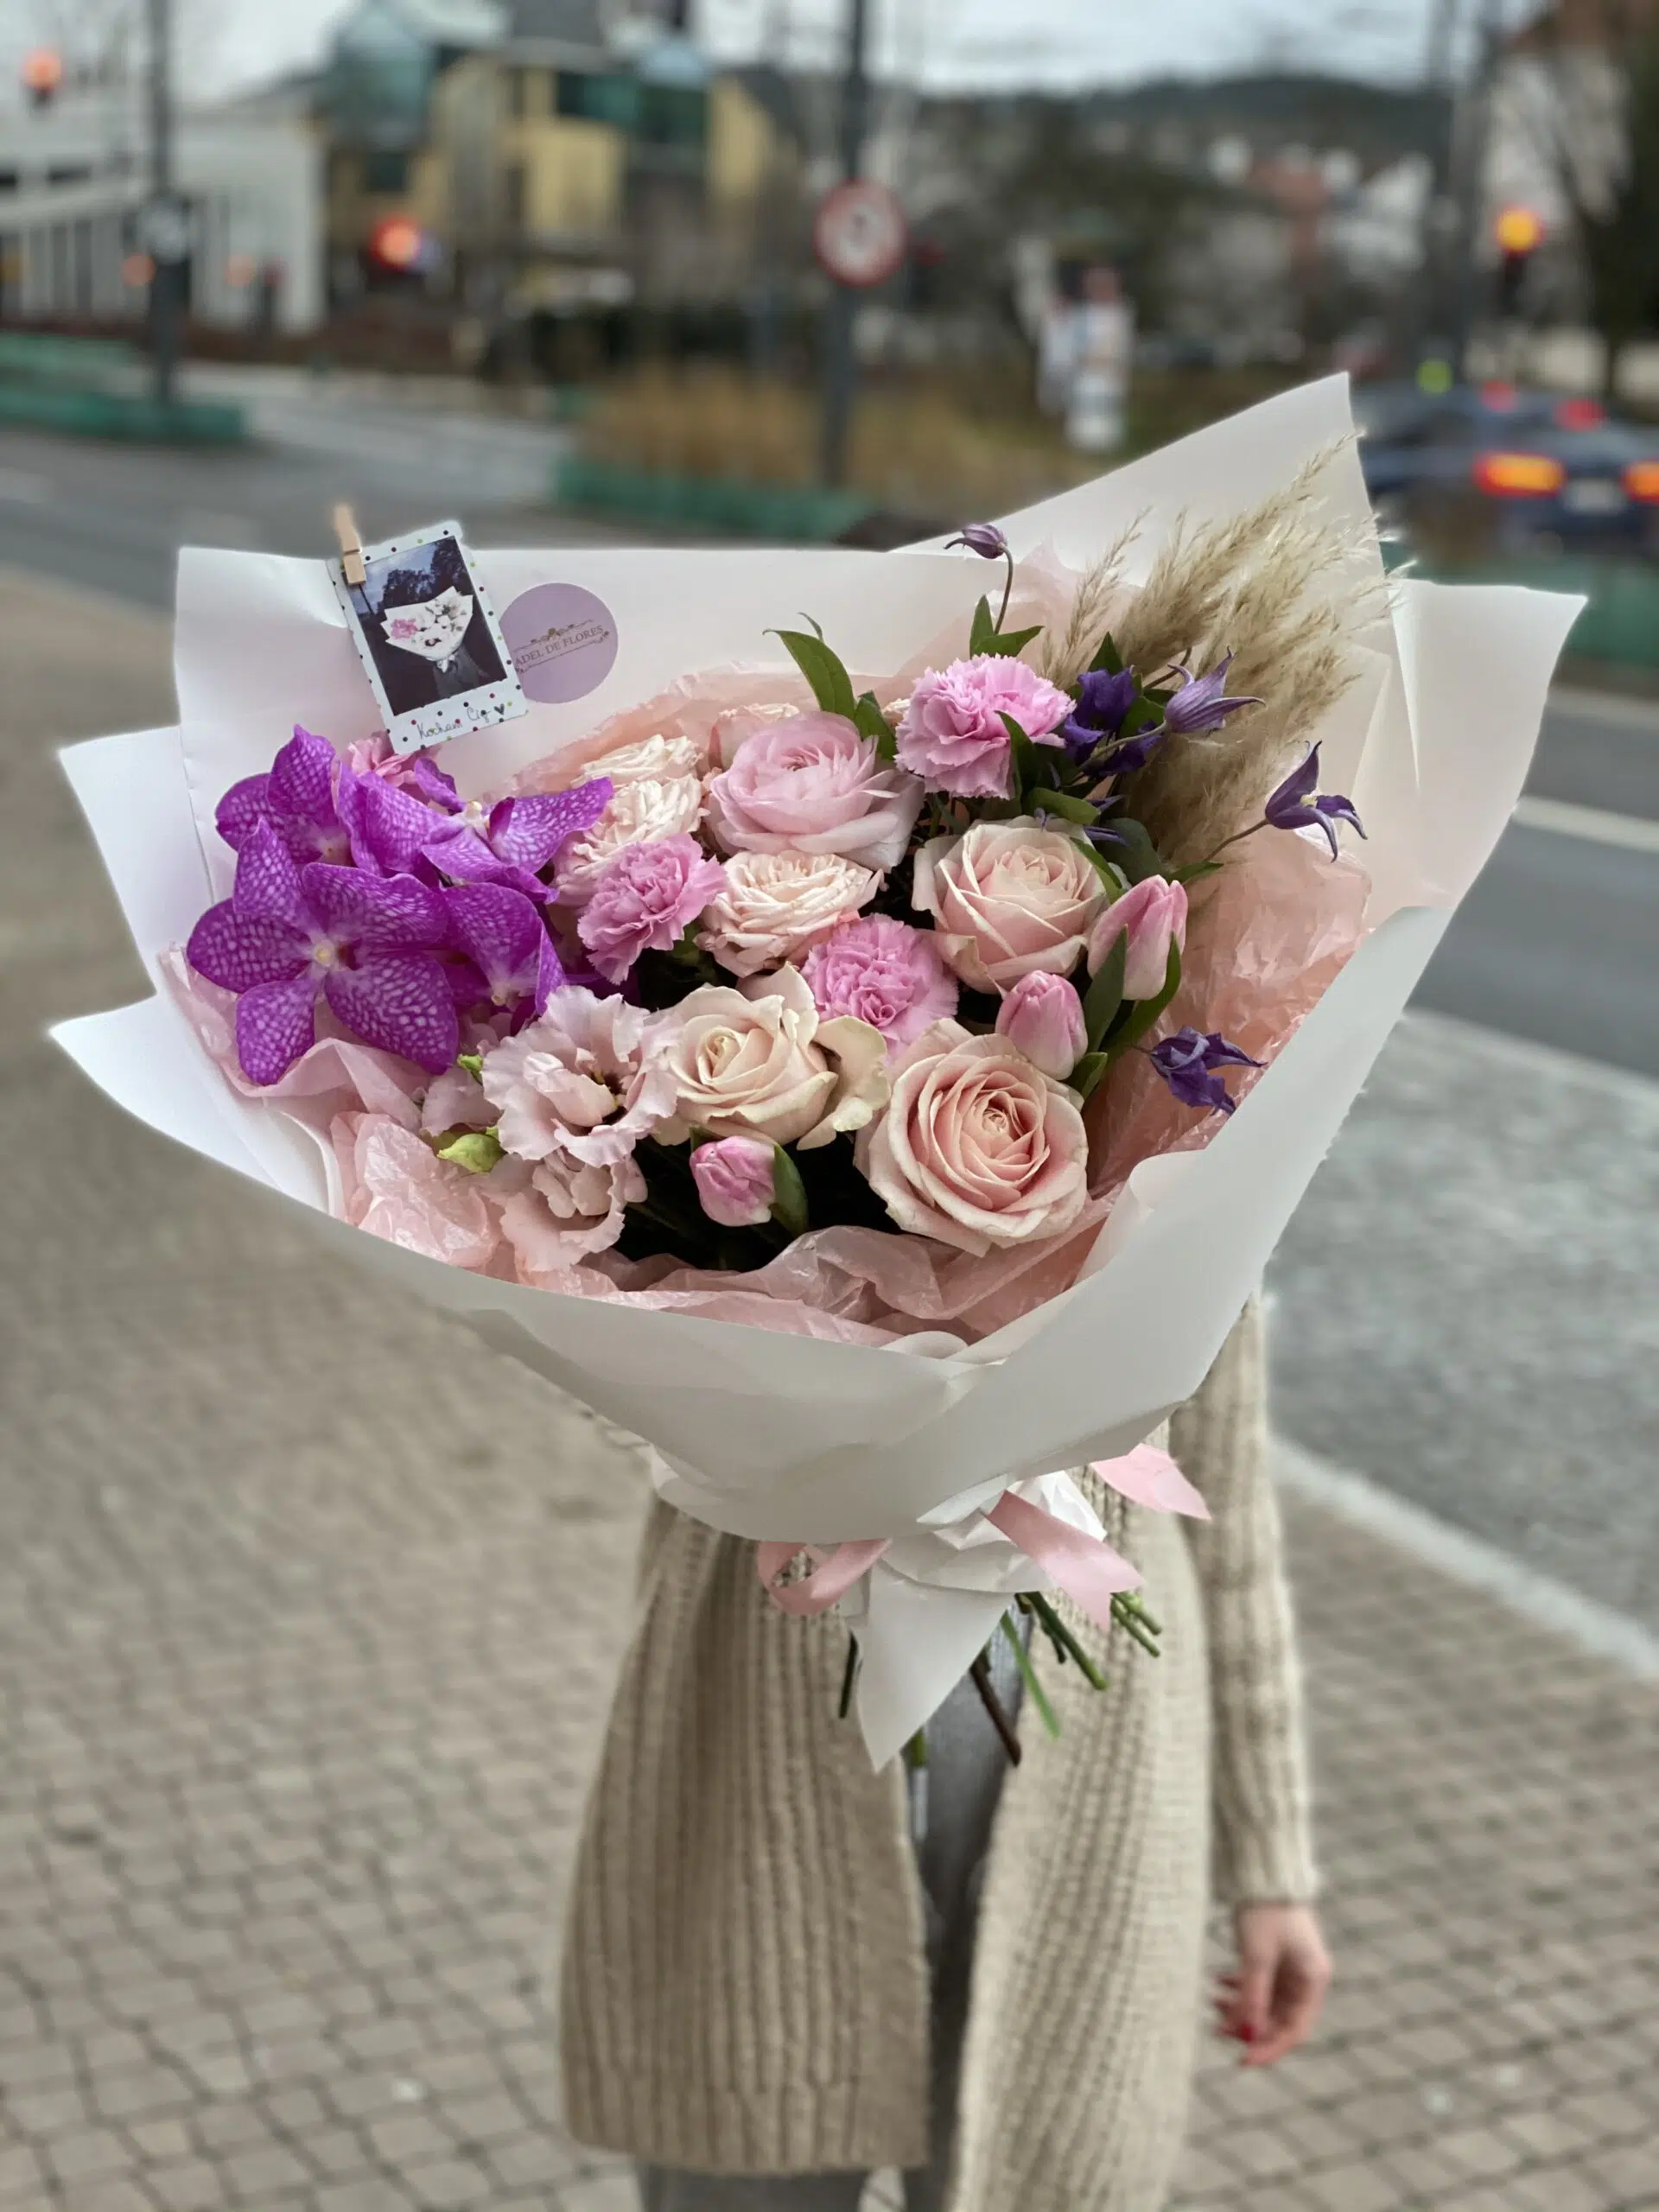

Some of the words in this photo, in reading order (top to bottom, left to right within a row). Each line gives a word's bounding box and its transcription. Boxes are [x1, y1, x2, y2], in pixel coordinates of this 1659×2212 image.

[516, 649, 543, 666] ADEL
[544, 642, 562, 654] DE
[563, 625, 604, 647] FLORES
